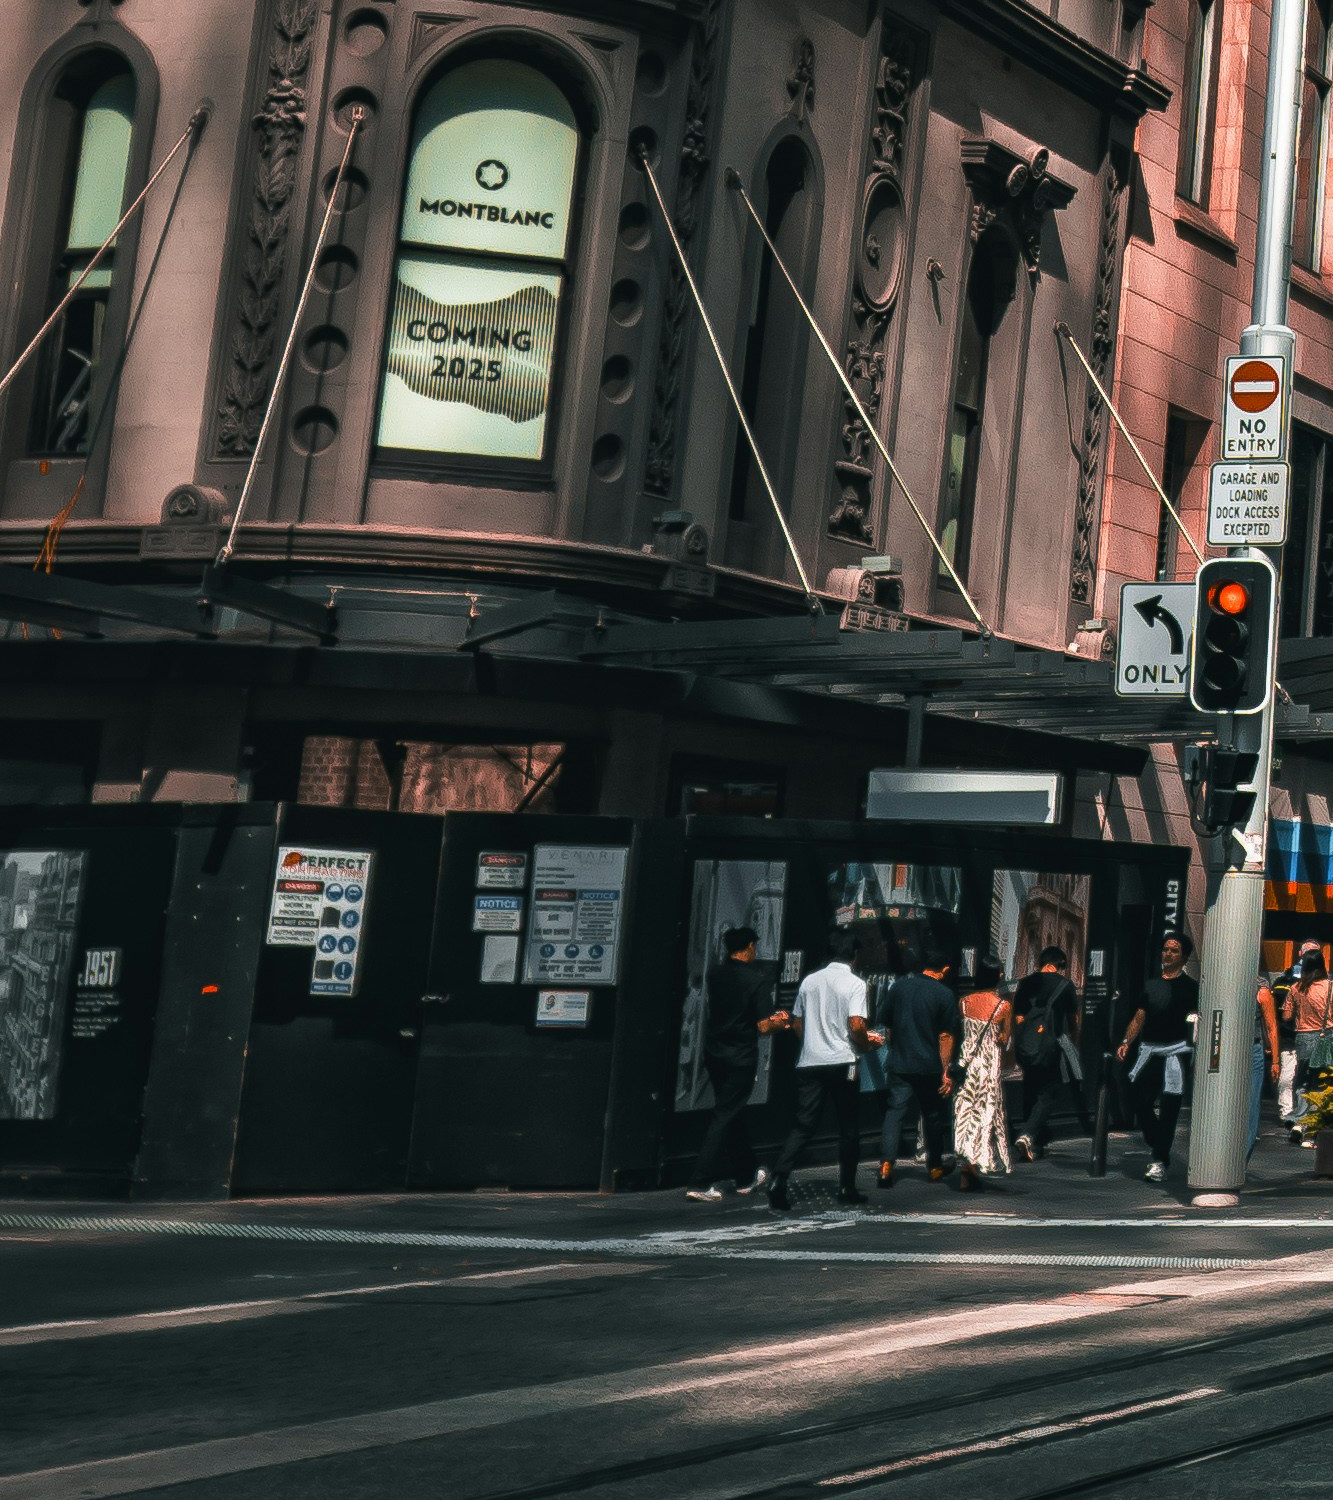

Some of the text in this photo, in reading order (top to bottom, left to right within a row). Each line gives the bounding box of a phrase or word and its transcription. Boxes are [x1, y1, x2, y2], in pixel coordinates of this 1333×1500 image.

[419, 197, 554, 230] MONTBLANC
[407, 320, 532, 352] COMING
[430, 356, 502, 382] 2025
[1239, 419, 1266, 434] NO
[1228, 439, 1276, 451] ENTRY
[1220, 473, 1280, 485] GARAGE AND
[1229, 489, 1268, 501] LOADING
[1216, 506, 1280, 519] DOCK ACCESS
[1224, 523, 1270, 535] EXCEPTED
[1124, 664, 1190, 683] ONLY
[300, 856, 366, 870] PERFECT
[479, 899, 517, 909] NOTICE
[1165, 880, 1179, 925] CITY
